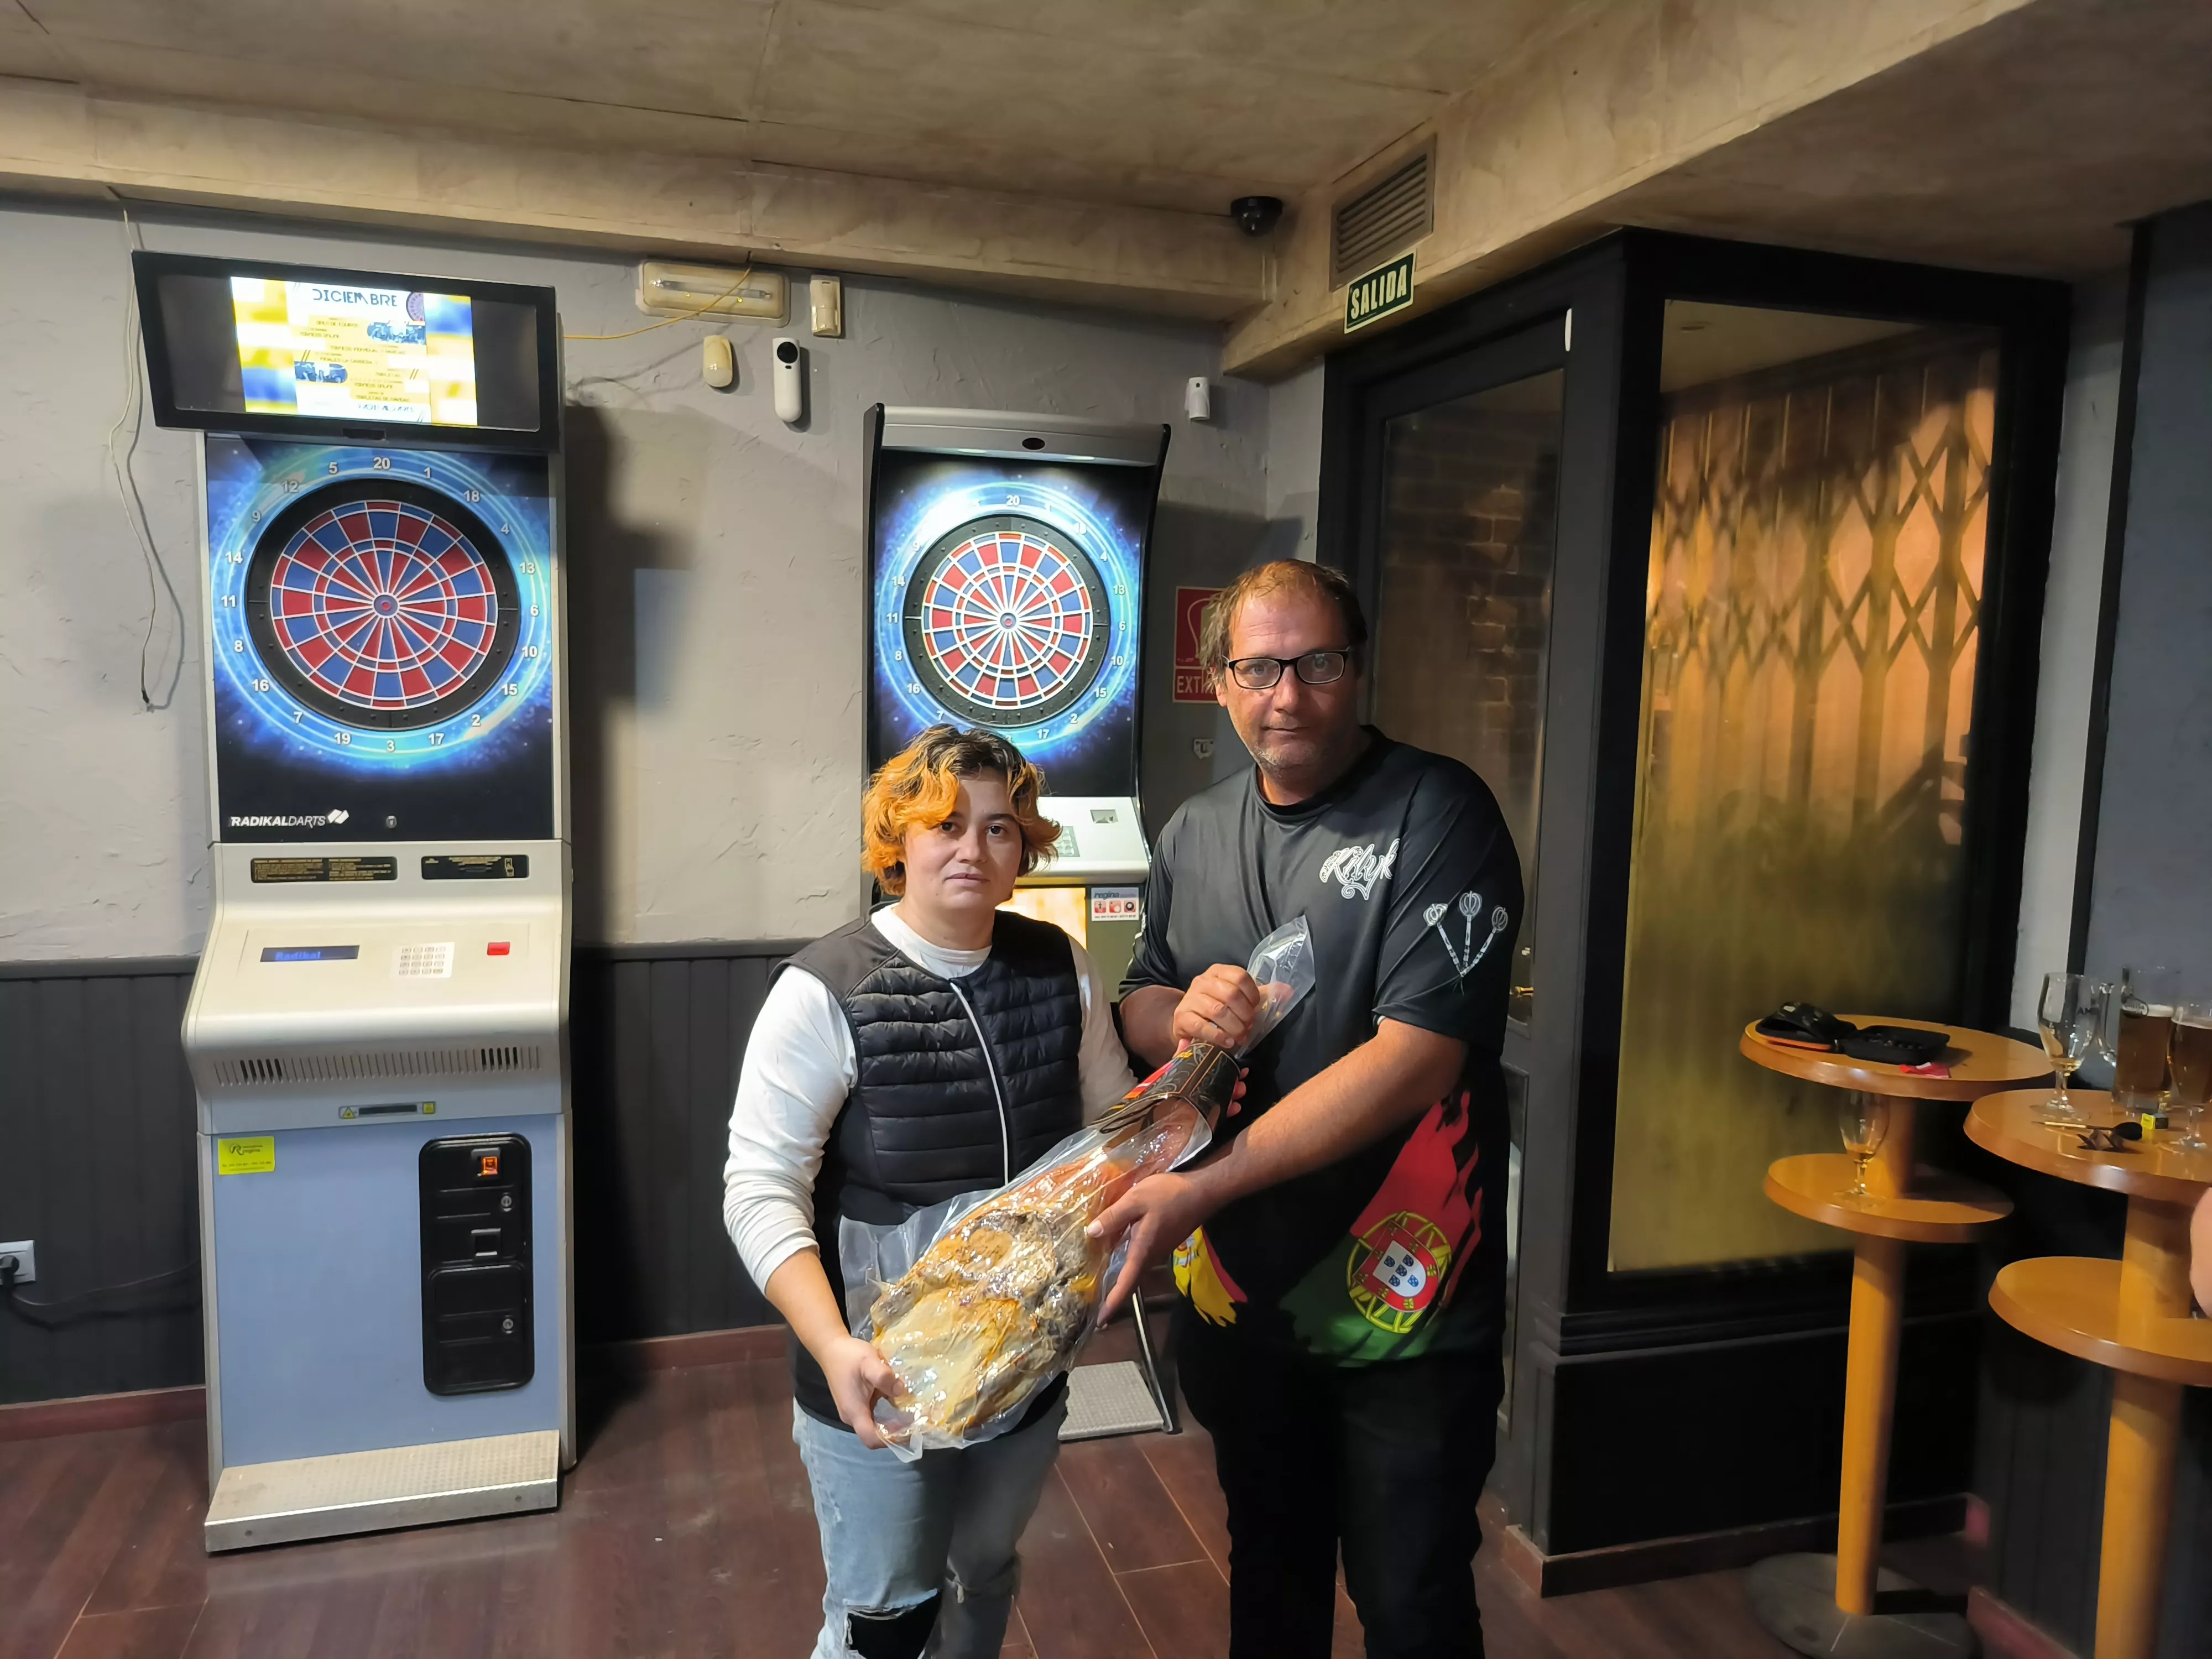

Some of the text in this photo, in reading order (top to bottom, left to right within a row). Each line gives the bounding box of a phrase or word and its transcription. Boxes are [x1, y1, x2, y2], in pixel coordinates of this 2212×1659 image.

[312, 288, 398, 307] DICIEMBRE
[1350, 264, 1407, 320] SALIDA
[329, 462, 338, 474] 5
[373, 457, 390, 469] 20
[424, 467, 431, 478] 1
[282, 481, 298, 493] 12
[464, 490, 480, 503] 18
[1006, 495, 1020, 506] 20
[252, 510, 261, 523] 9
[500, 523, 509, 535] 4
[226, 552, 243, 564] 14
[1100, 551, 1108, 561] 4
[519, 562, 535, 575] 13
[892, 576, 905, 587] 14
[1113, 585, 1125, 595] 13
[221, 595, 236, 607] 11
[530, 604, 539, 617] 6
[886, 612, 899, 623] 11
[1119, 620, 1126, 631] 6
[234, 640, 243, 653] 8
[522, 646, 538, 658] 10
[895, 650, 902, 661] 8
[1111, 656, 1123, 666] 10
[252, 680, 269, 691] 16
[502, 684, 518, 696] 15
[907, 683, 920, 694] 16
[1095, 688, 1107, 698] 15
[294, 712, 303, 723] 7
[472, 715, 481, 726] 2
[937, 710, 945, 721] 7
[1071, 713, 1078, 724] 2
[335, 733, 351, 745] 19
[429, 733, 444, 745] 17
[1037, 729, 1050, 739] 17
[387, 740, 395, 752] 3
